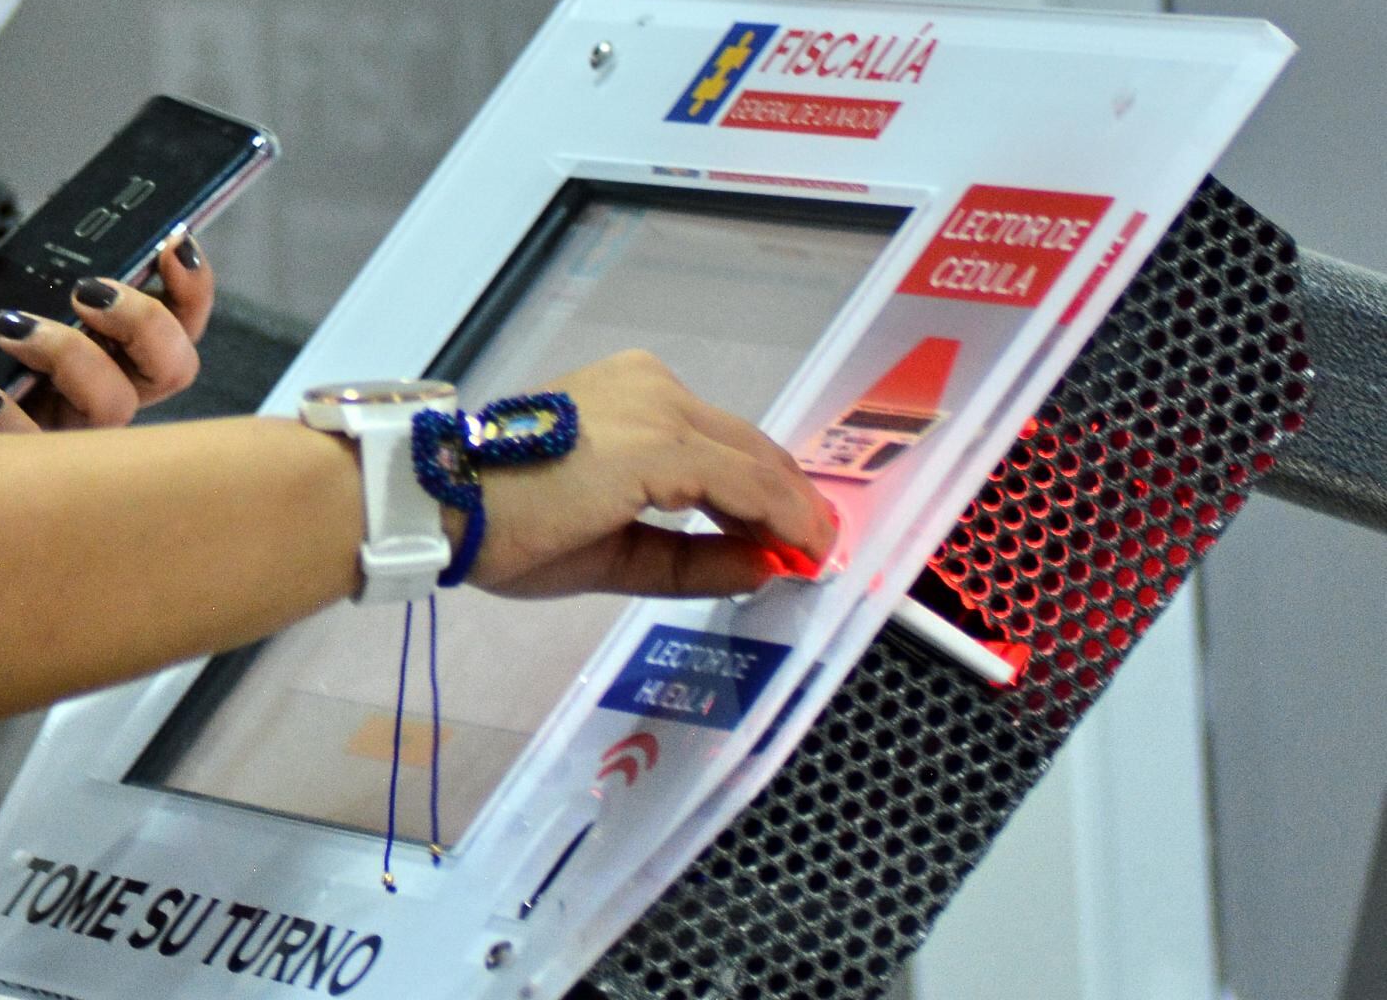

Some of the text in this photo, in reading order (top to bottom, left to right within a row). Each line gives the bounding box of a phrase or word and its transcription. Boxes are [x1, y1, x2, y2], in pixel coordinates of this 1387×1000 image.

[758, 21, 939, 84] FISCALÍA
[940, 207, 1093, 252] LECTOR DE
[644, 638, 728, 675] LECTOR
[0, 857, 383, 997] TOME SU TURNO
